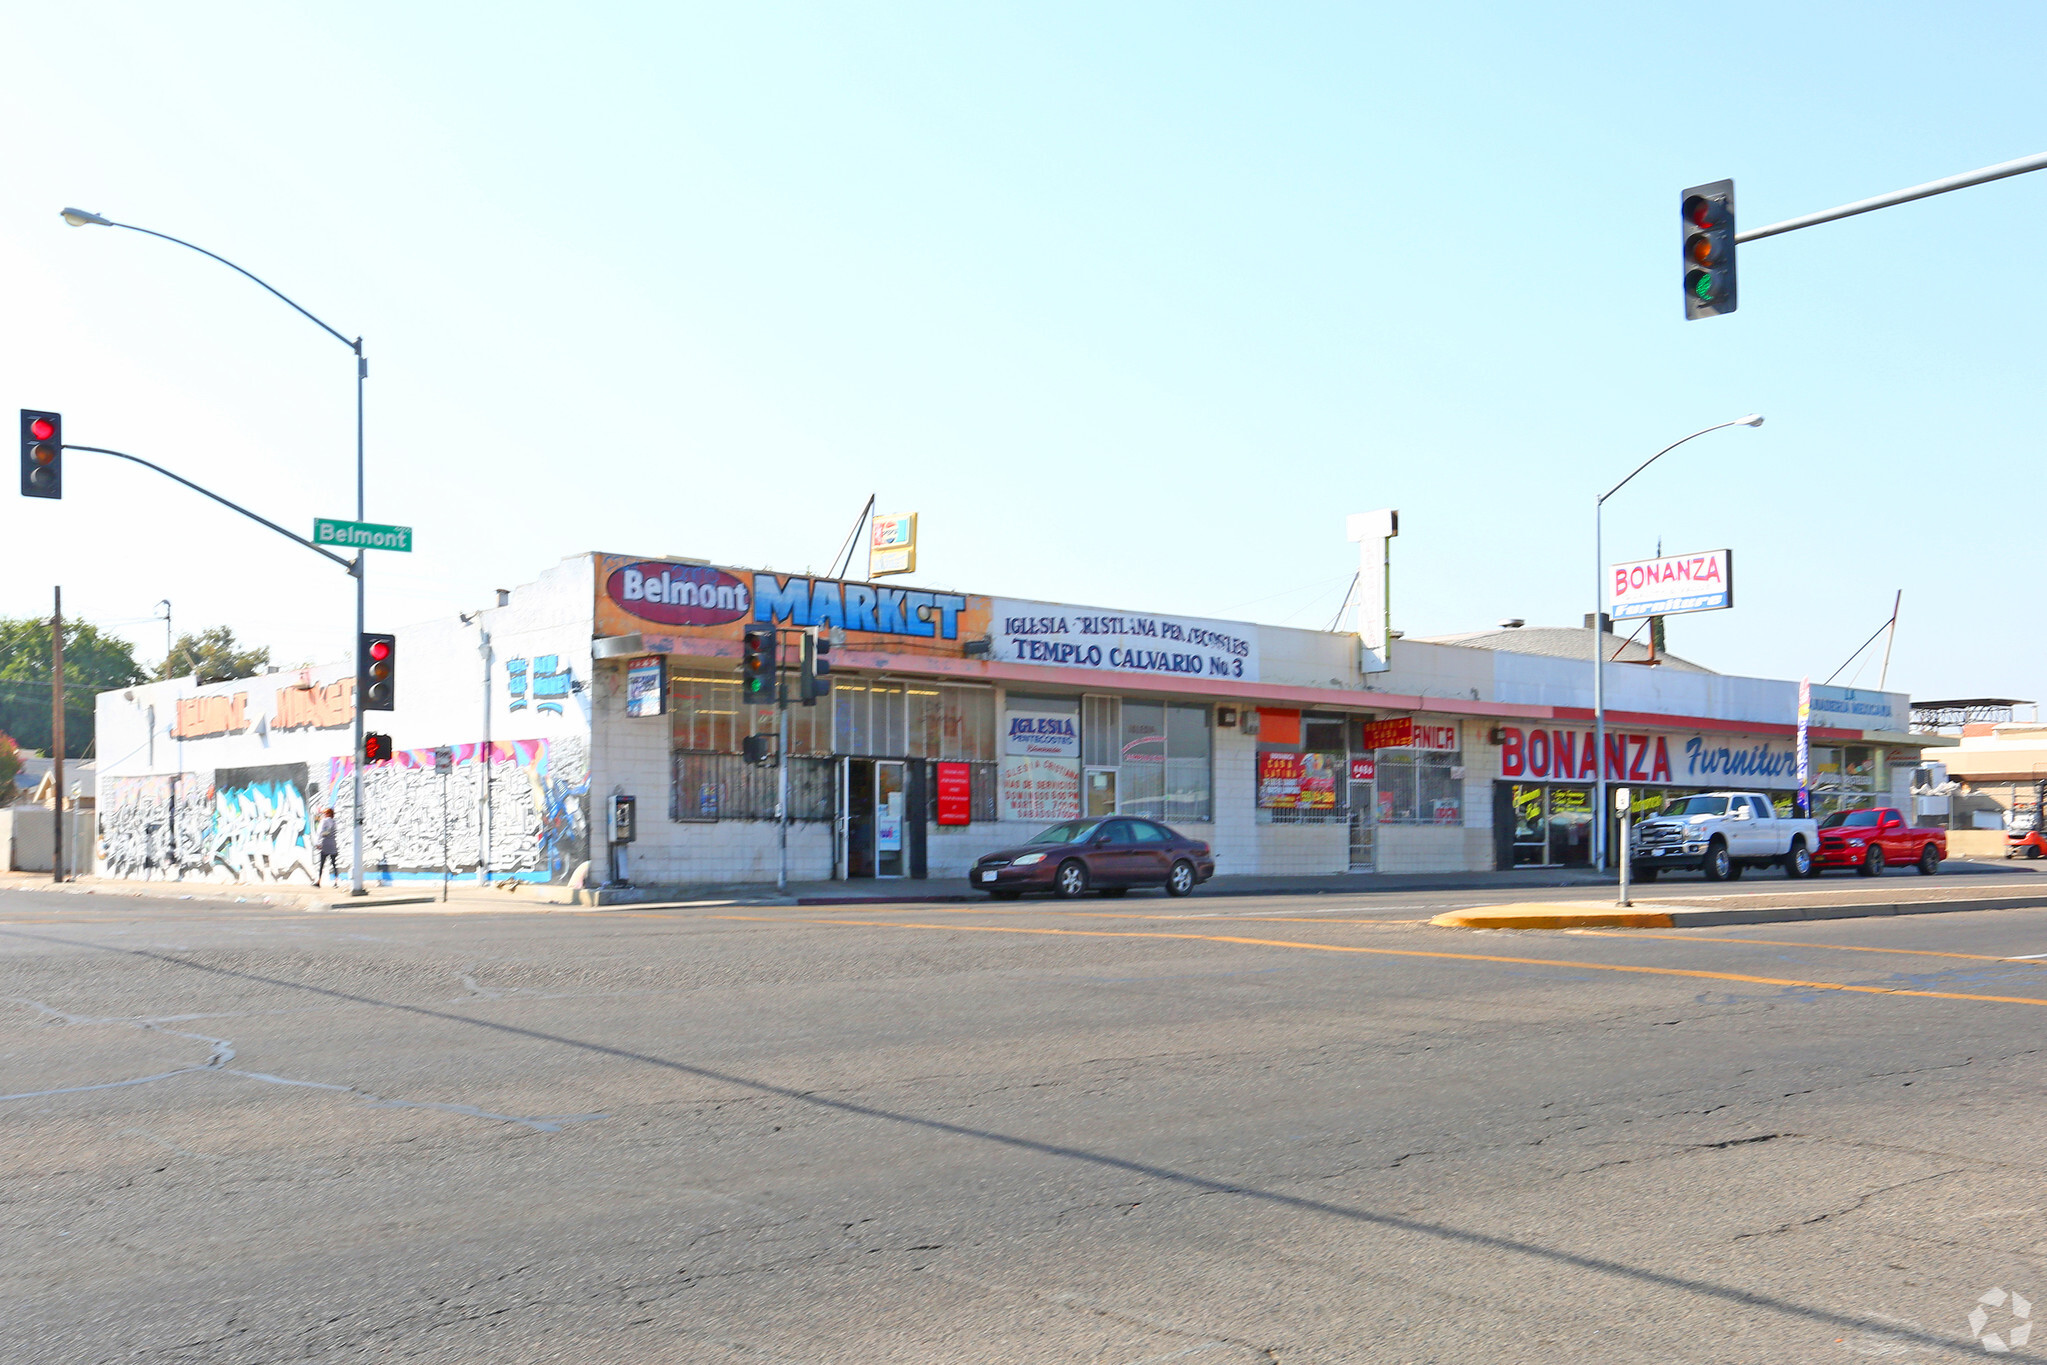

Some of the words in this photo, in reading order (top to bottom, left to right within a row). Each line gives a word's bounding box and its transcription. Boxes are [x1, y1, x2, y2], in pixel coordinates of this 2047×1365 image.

[320, 523, 407, 548] Belmont
[1616, 556, 1721, 596] BONANZA
[623, 568, 750, 612] Belmont
[753, 573, 966, 642] MARKET
[1615, 594, 1723, 617] Furniture
[1004, 617, 1069, 636] IGLESIA
[1072, 616, 1157, 638] RISTINA
[1011, 638, 1102, 666] TEMPLO
[1109, 647, 1202, 674] CALVARIO
[1232, 659, 1244, 678] 3
[1008, 717, 1077, 738] IGLESIA
[1413, 725, 1454, 750] ANICA
[1502, 726, 1673, 782] BONANZA
[1686, 736, 1798, 777] Furnitur
[1004, 760, 1040, 778] GLESIA
